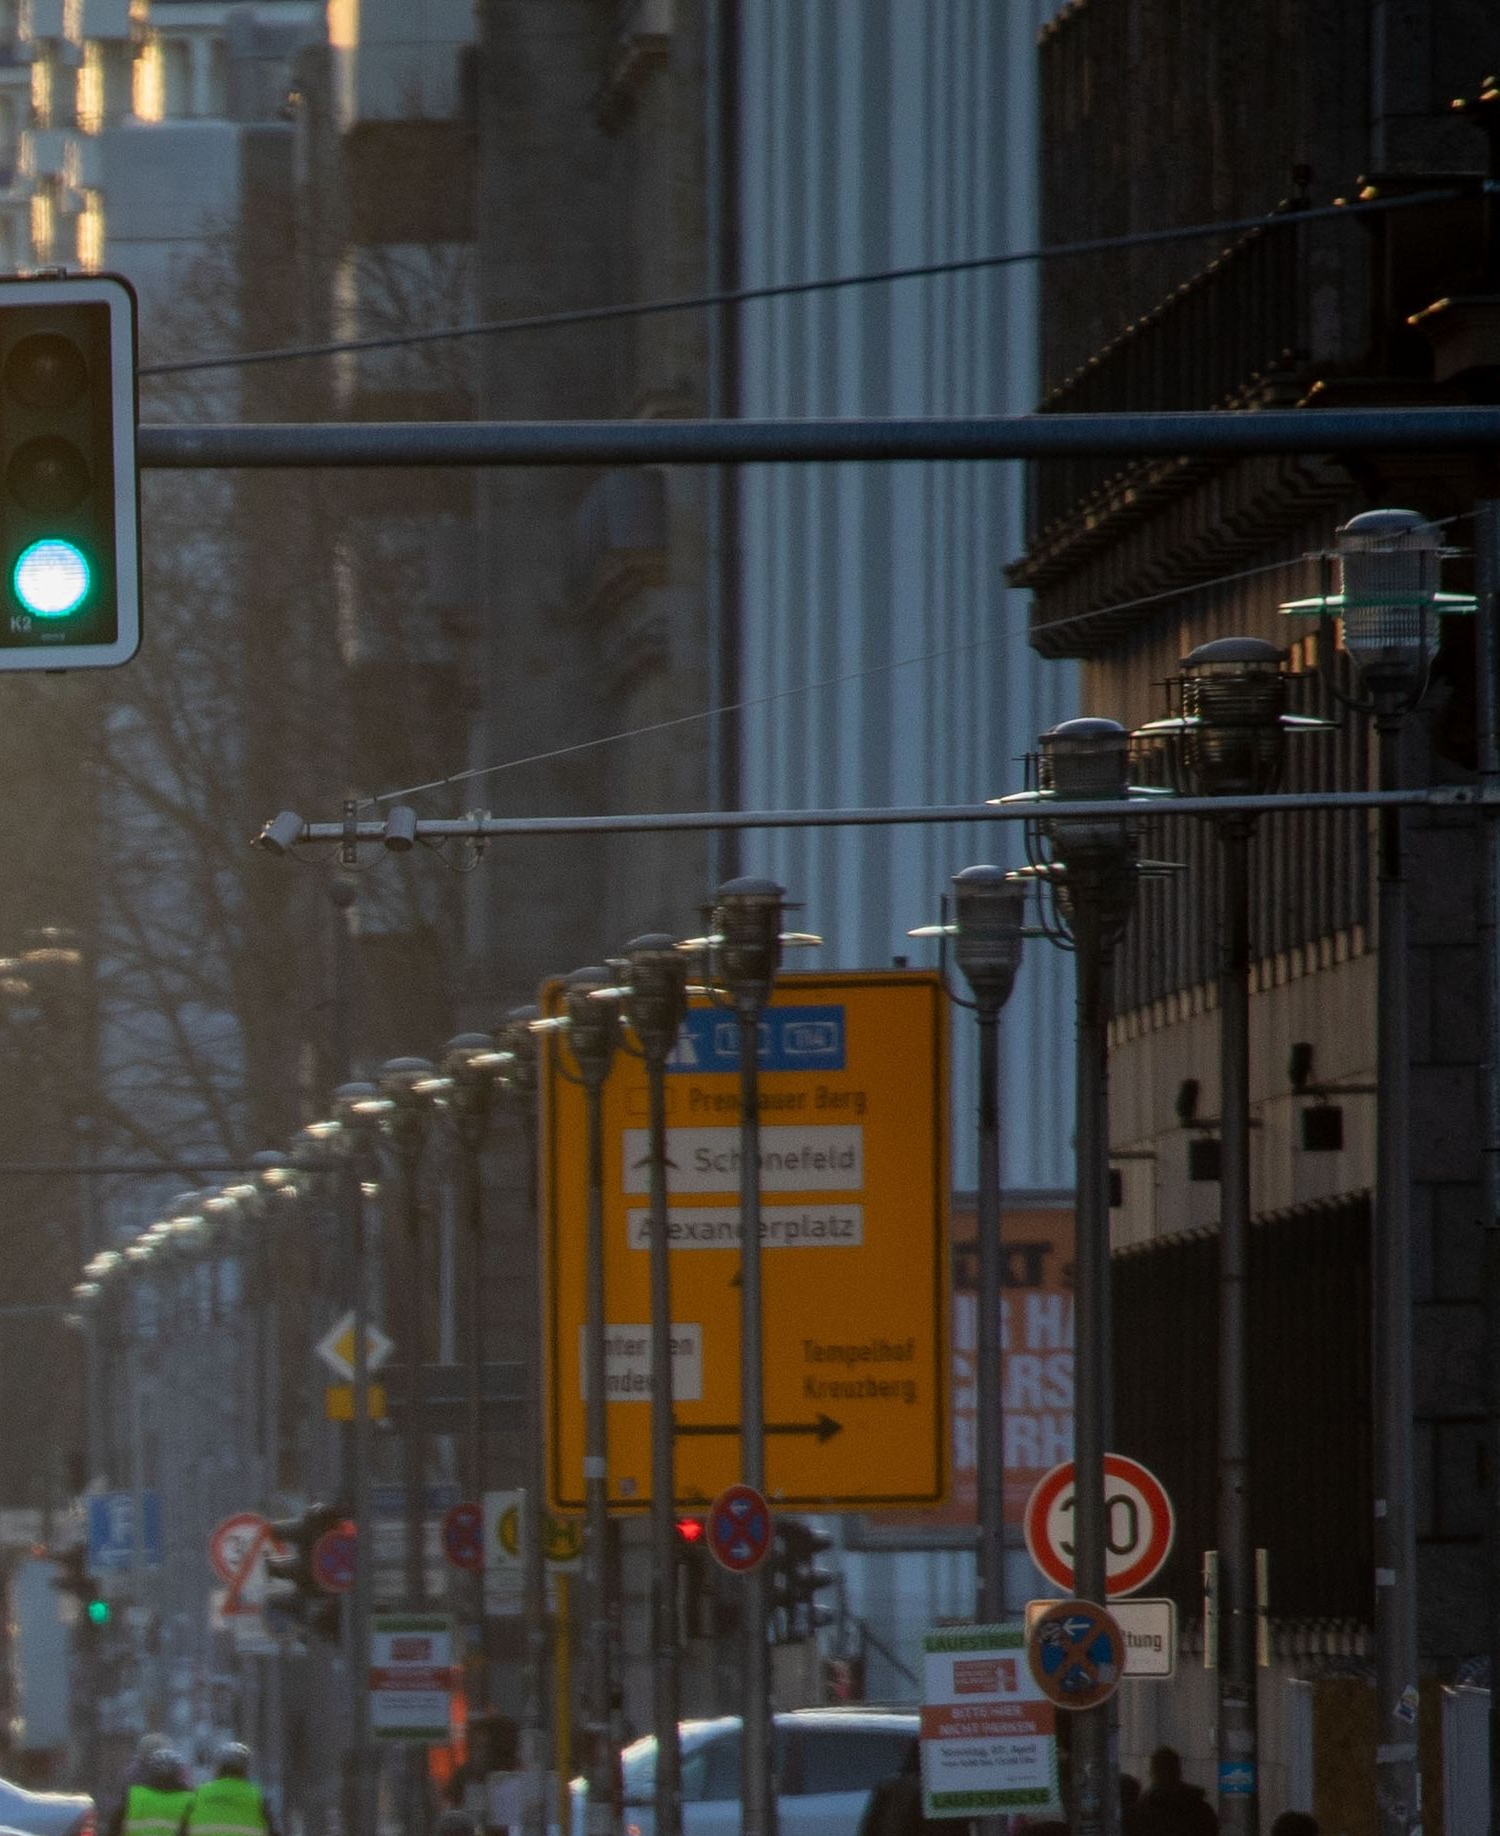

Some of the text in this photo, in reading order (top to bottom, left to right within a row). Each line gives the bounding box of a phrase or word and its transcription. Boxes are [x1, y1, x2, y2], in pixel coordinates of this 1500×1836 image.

[815, 1087, 866, 1114] Berg
[695, 1147, 856, 1173] Schnefeld
[804, 1338, 914, 1366] Tempelhof
[804, 1377, 916, 1404] Kreuzberg
